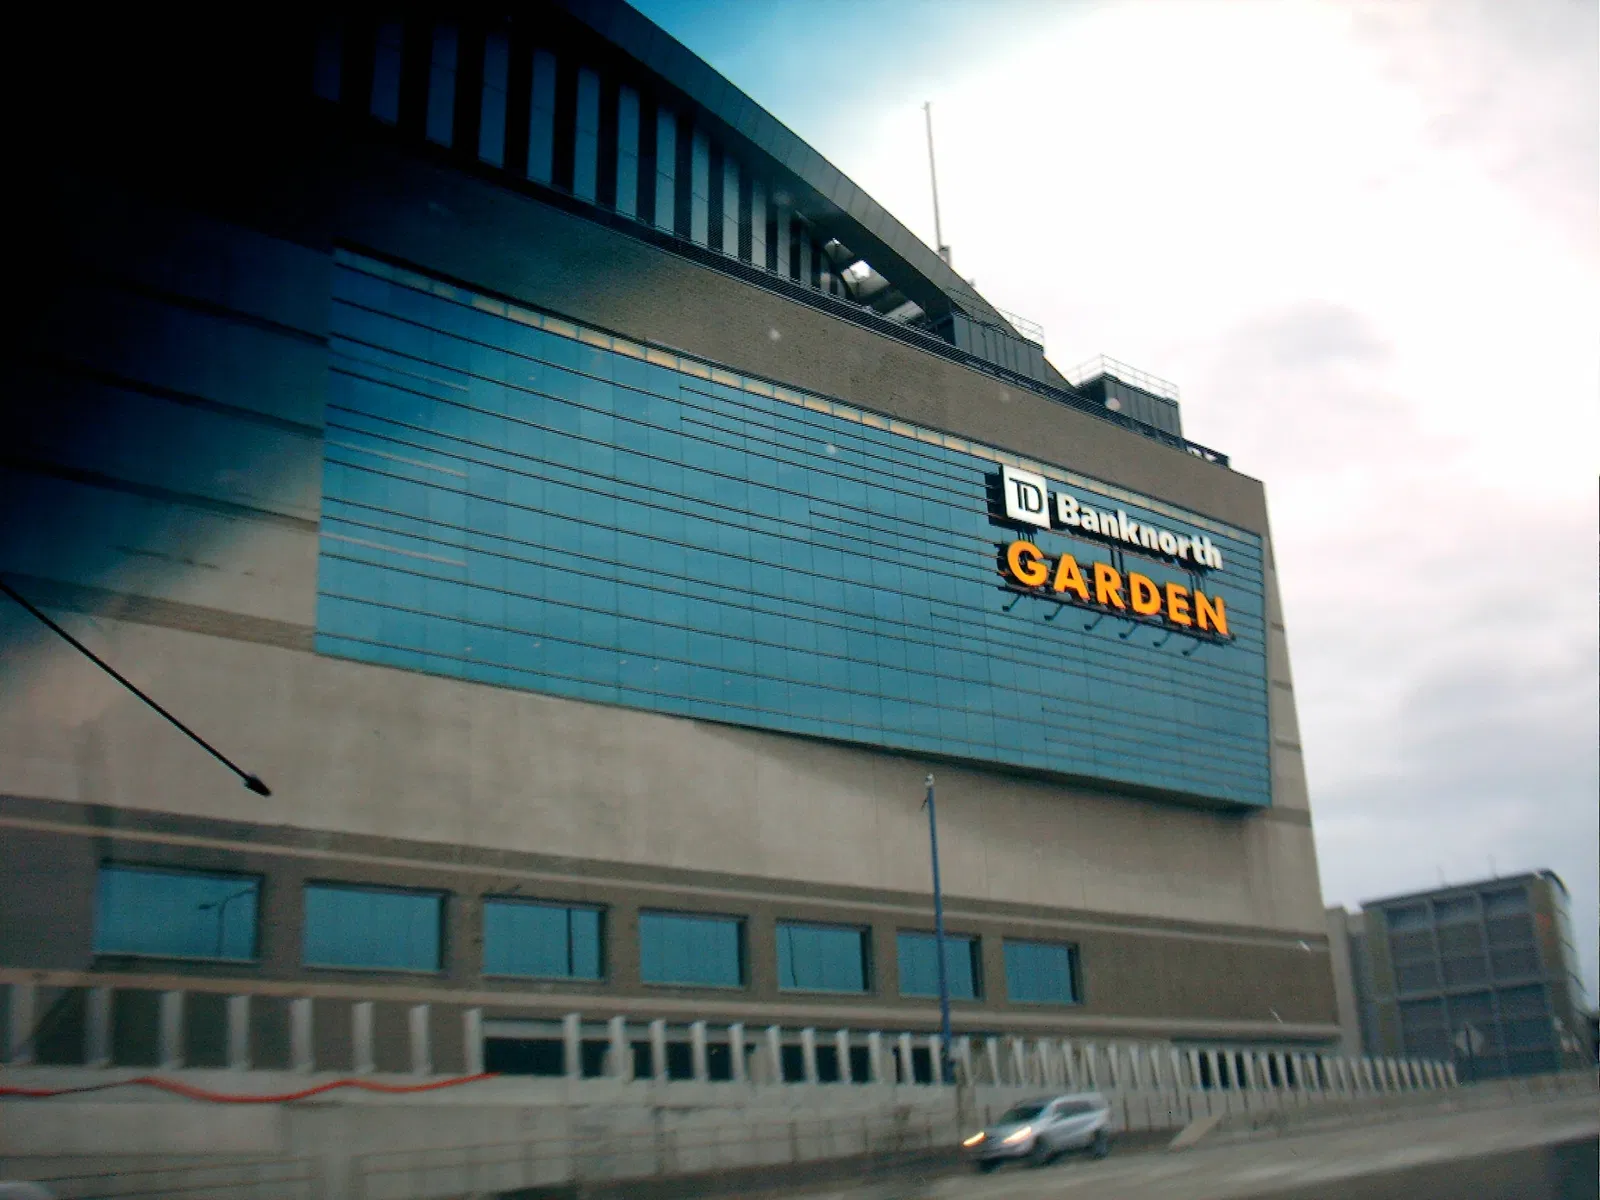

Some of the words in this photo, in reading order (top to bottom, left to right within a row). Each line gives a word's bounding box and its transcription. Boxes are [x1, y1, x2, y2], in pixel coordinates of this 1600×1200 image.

[1009, 477, 1043, 514] TD
[1056, 491, 1223, 570] Banknorth
[1007, 540, 1229, 635] GARDEN
